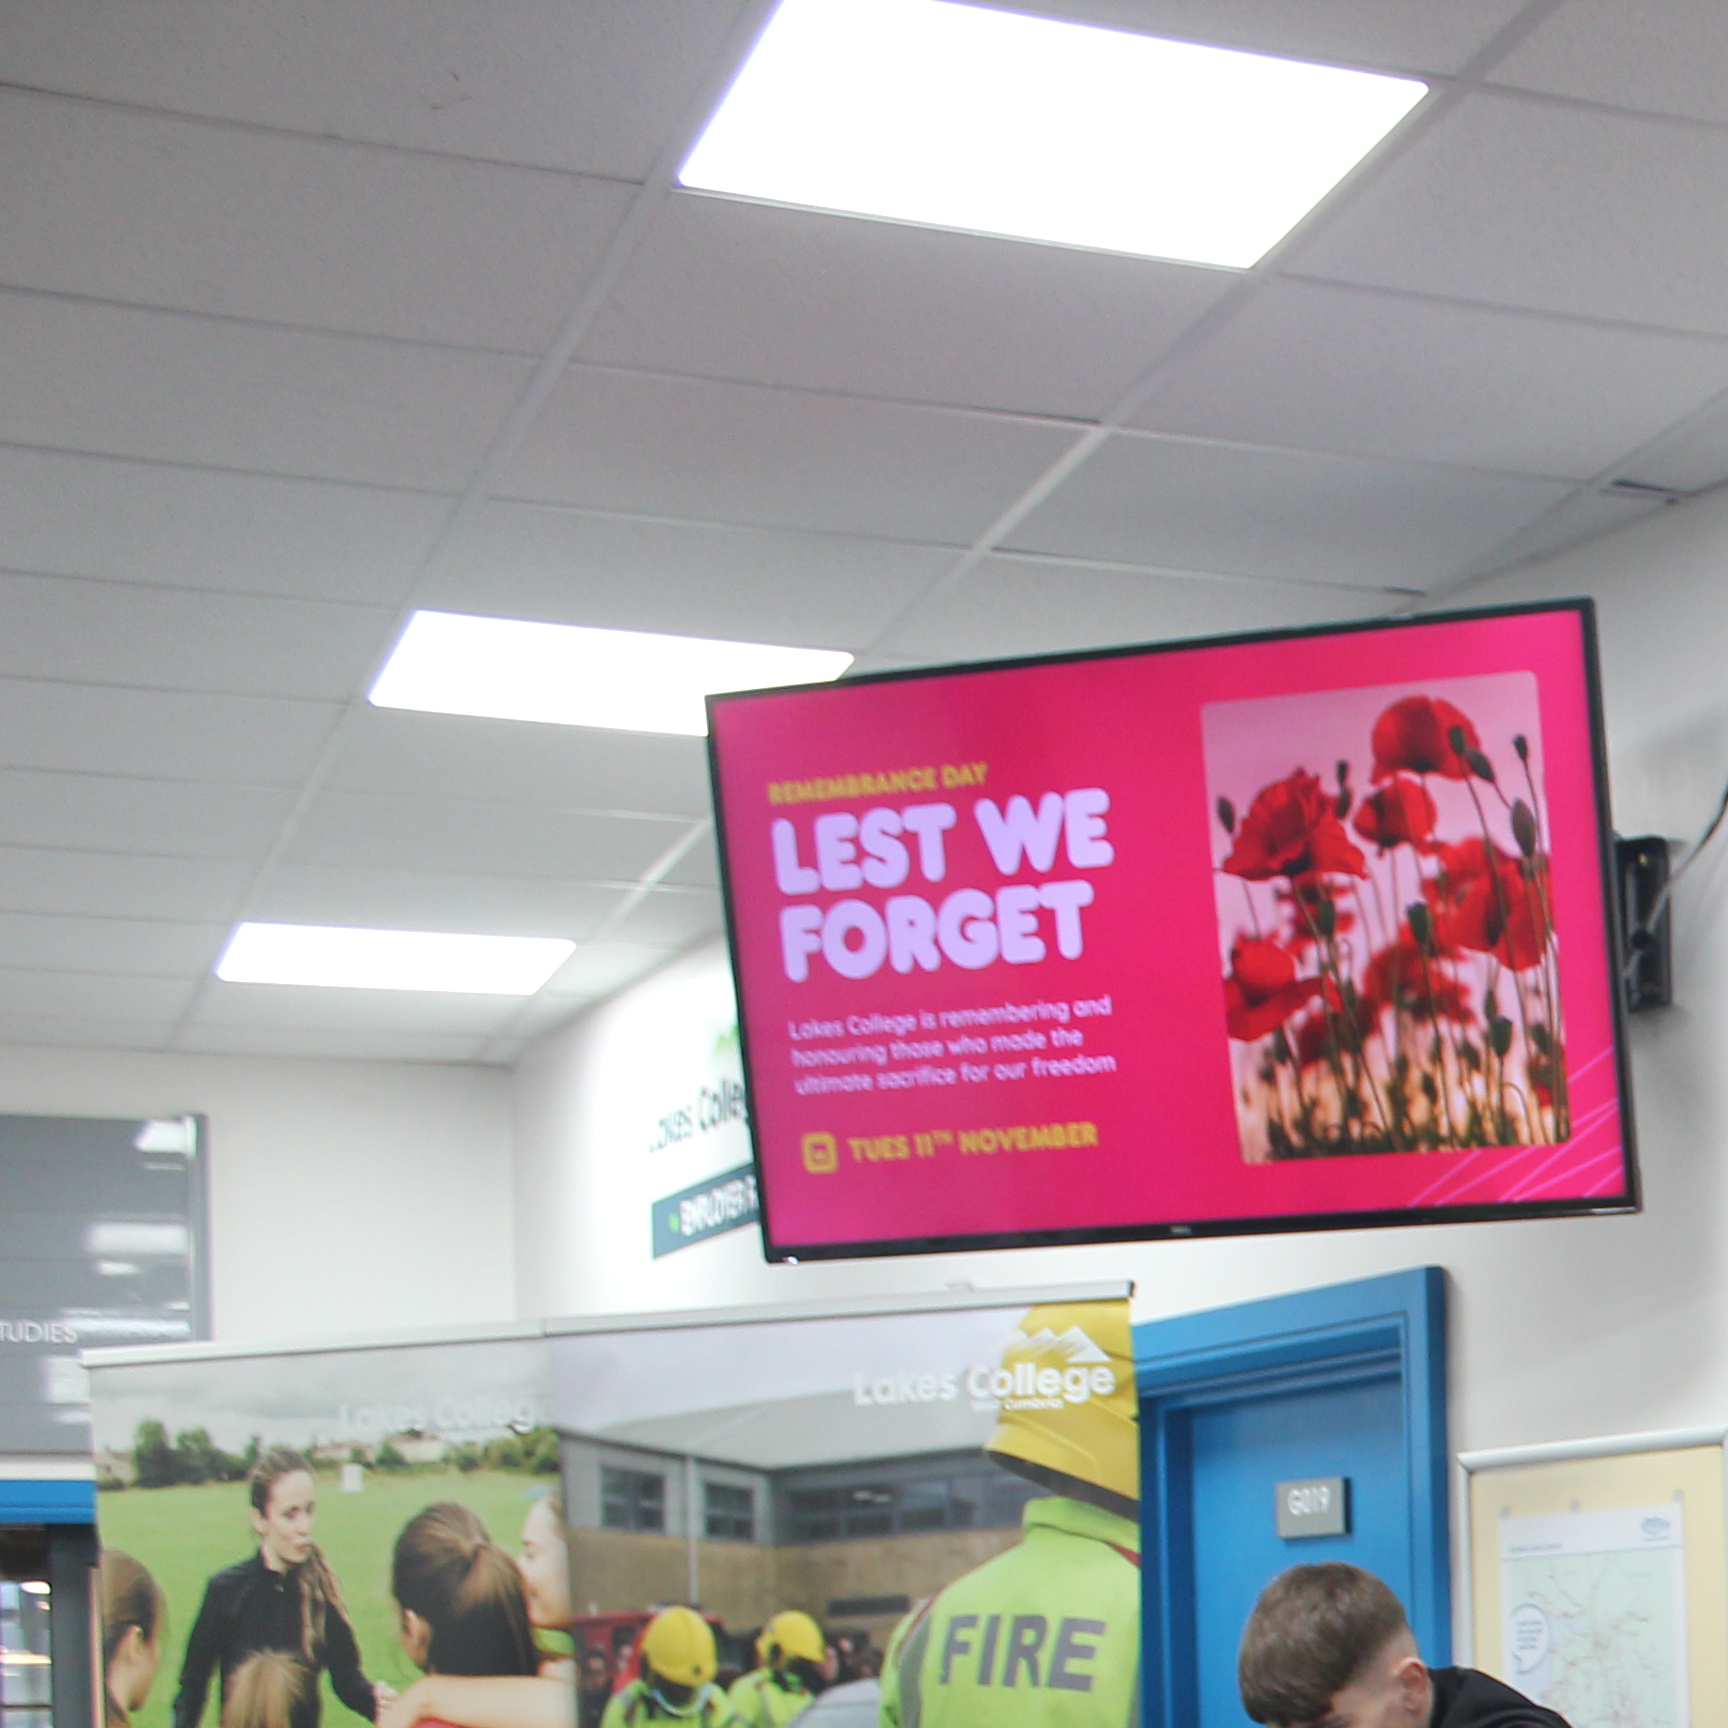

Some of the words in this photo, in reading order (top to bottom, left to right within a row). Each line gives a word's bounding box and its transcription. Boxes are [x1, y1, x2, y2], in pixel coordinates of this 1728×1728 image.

[768, 766, 937, 806] REMEMBRANCE
[940, 761, 988, 787] DAY
[771, 801, 958, 895] LEST
[973, 787, 1115, 876] WE
[779, 879, 1095, 983] FORGET
[788, 1018, 845, 1041] Lakes
[847, 1011, 917, 1036] College
[920, 1009, 937, 1030] is
[938, 1001, 1070, 1028] remembering
[1072, 994, 1113, 1018] and
[791, 1044, 889, 1067] honouring
[889, 1039, 944, 1060] those
[946, 1034, 988, 1055] who
[990, 1030, 1047, 1051] made
[1050, 1027, 1084, 1047] the
[794, 1073, 873, 1096] ultimate
[876, 1065, 957, 1089] sacrifice
[959, 1061, 991, 1082] for
[993, 1062, 1027, 1081] our
[1031, 1054, 1117, 1077] freedom
[847, 1135, 910, 1162] TUES
[958, 1121, 1098, 1155] NOVEMBER
[854, 1371, 958, 1406] Lakes
[966, 1361, 1116, 1405] College
[938, 1611, 1107, 1693] FIRE
